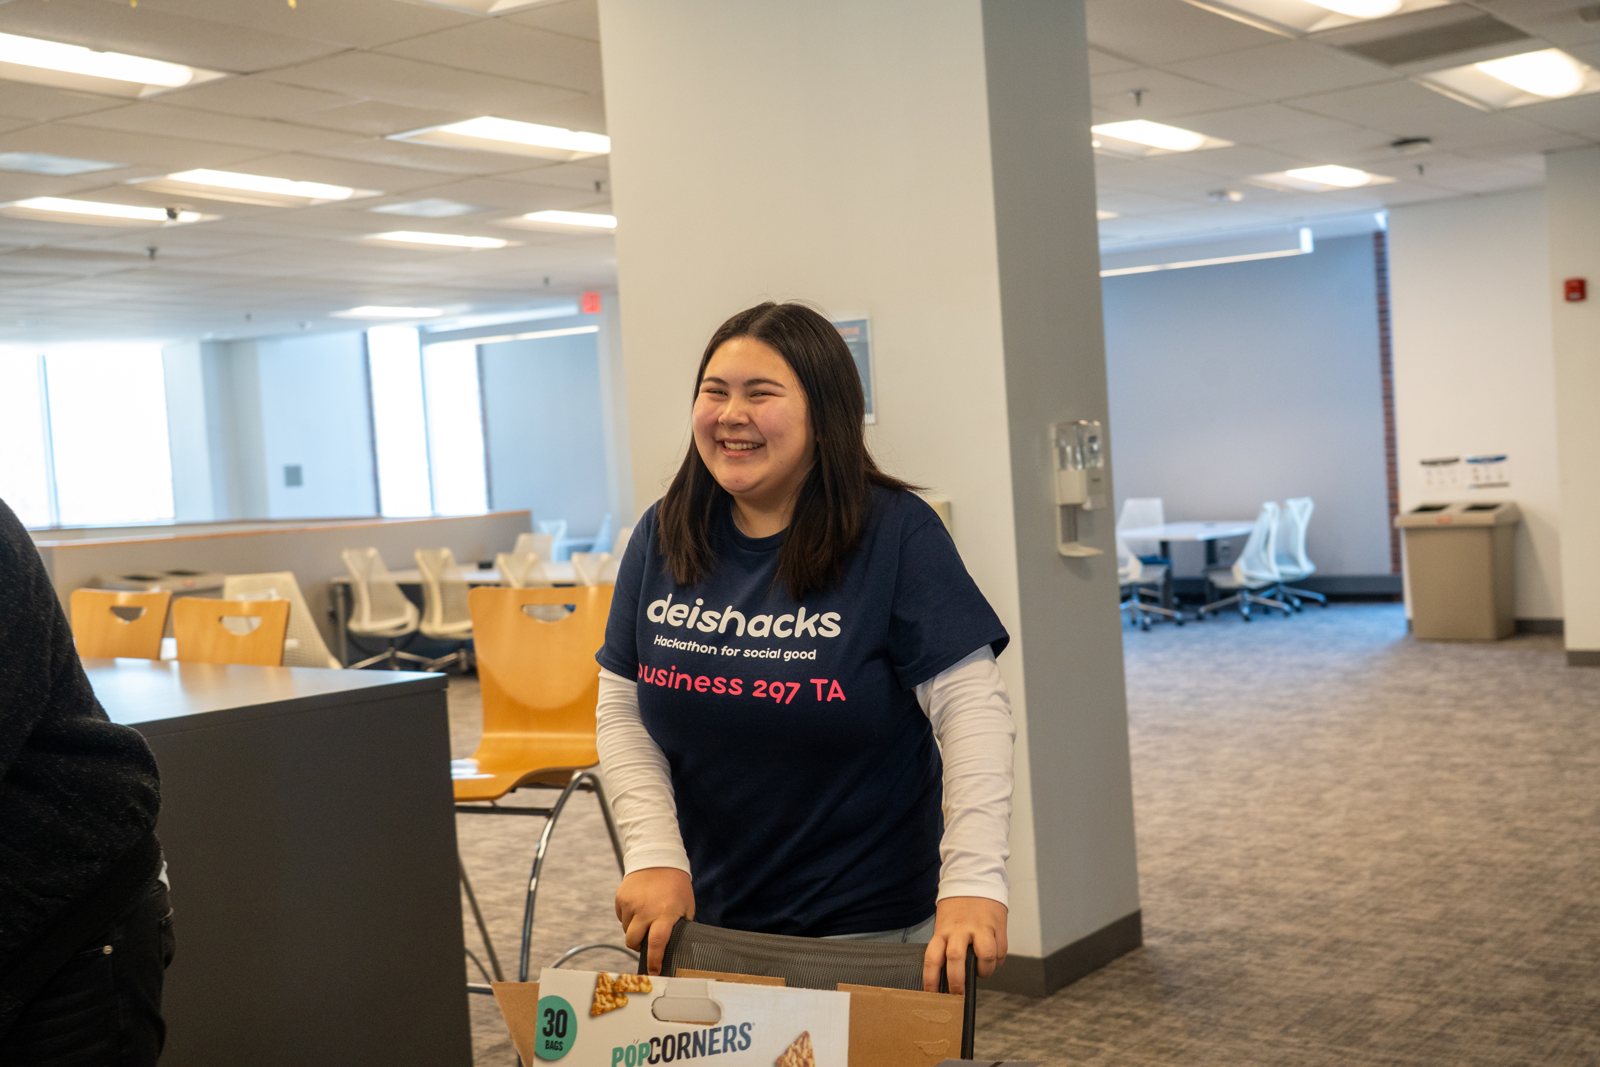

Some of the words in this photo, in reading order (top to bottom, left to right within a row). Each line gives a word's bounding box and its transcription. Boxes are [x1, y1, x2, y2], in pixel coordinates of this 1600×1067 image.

[646, 593, 842, 638] deishacks
[653, 634, 718, 655] Hackathon
[720, 645, 741, 657] for
[743, 647, 782, 659] social
[783, 649, 817, 662] good
[752, 679, 801, 704] 297
[809, 678, 847, 702] TA
[542, 1007, 568, 1039] 30
[545, 1039, 564, 1051] BAGS
[611, 1021, 753, 1067] POPCORNERS
